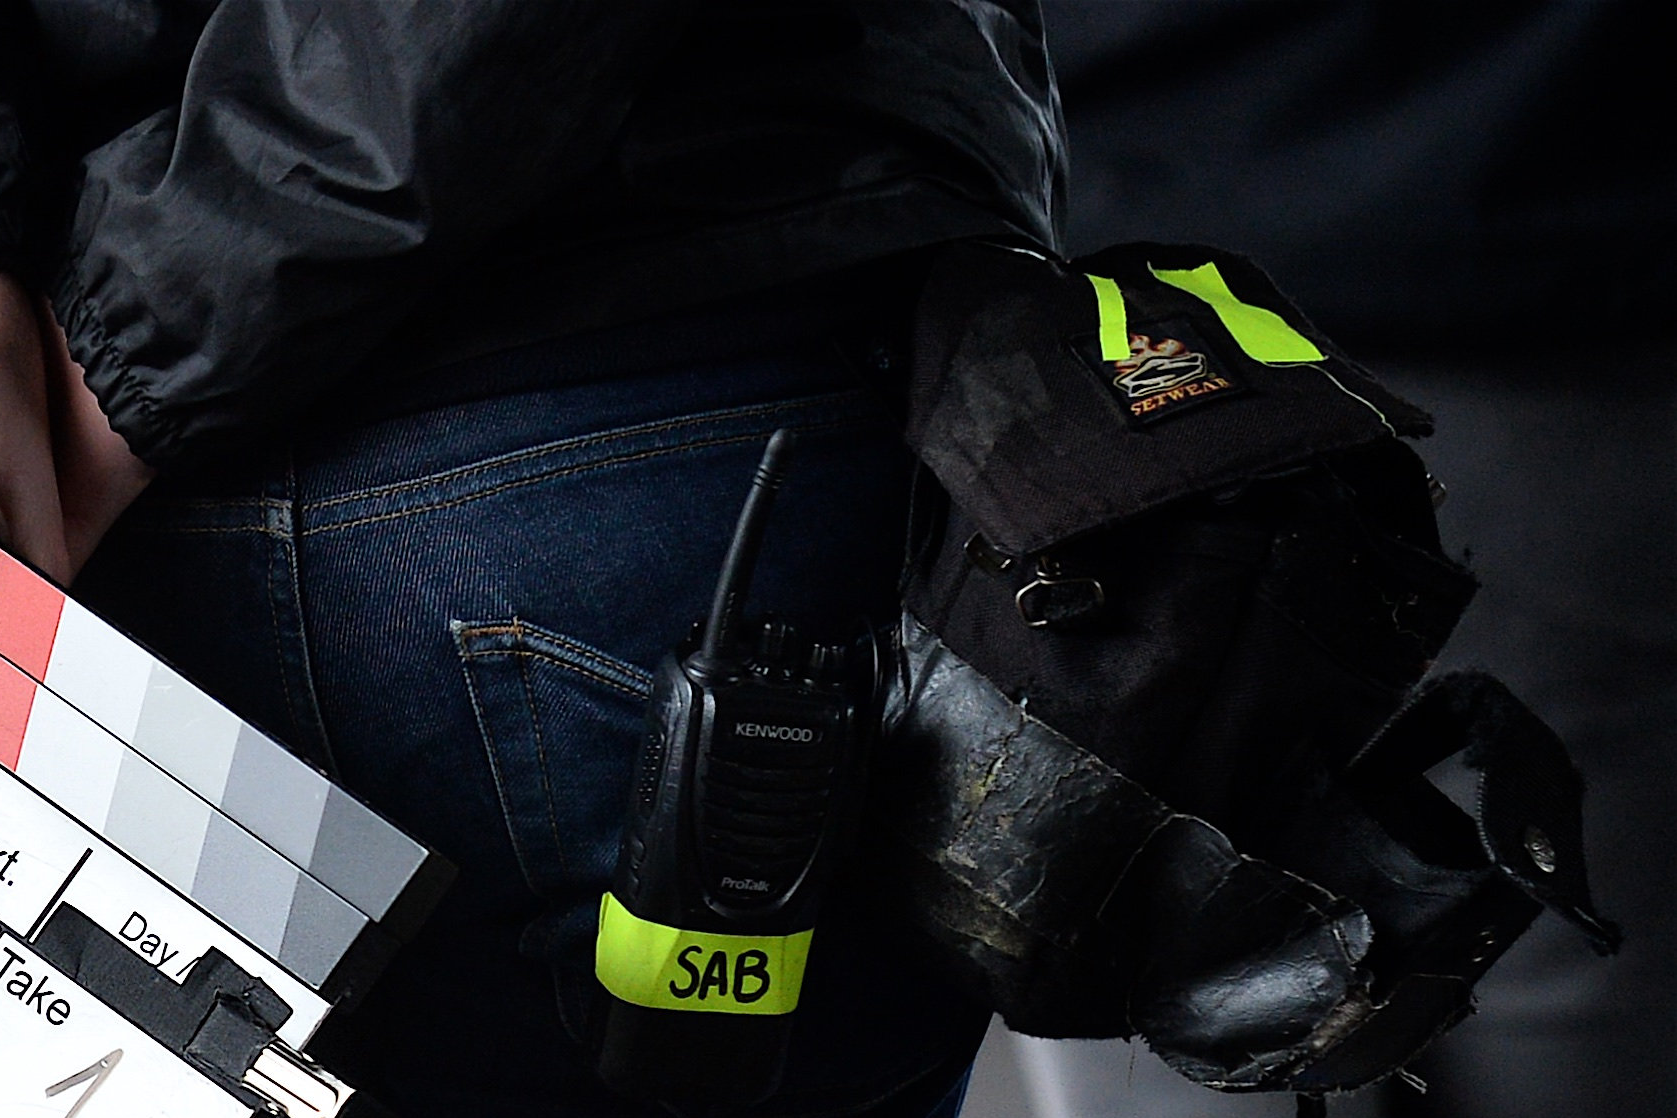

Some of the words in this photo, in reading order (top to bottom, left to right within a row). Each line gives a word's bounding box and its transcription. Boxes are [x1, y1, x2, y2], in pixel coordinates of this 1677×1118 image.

[1130, 377, 1231, 416] SETWEAR
[735, 721, 813, 743] KENWOOD
[722, 876, 770, 893] ProTalk
[669, 944, 771, 1004] SAB
